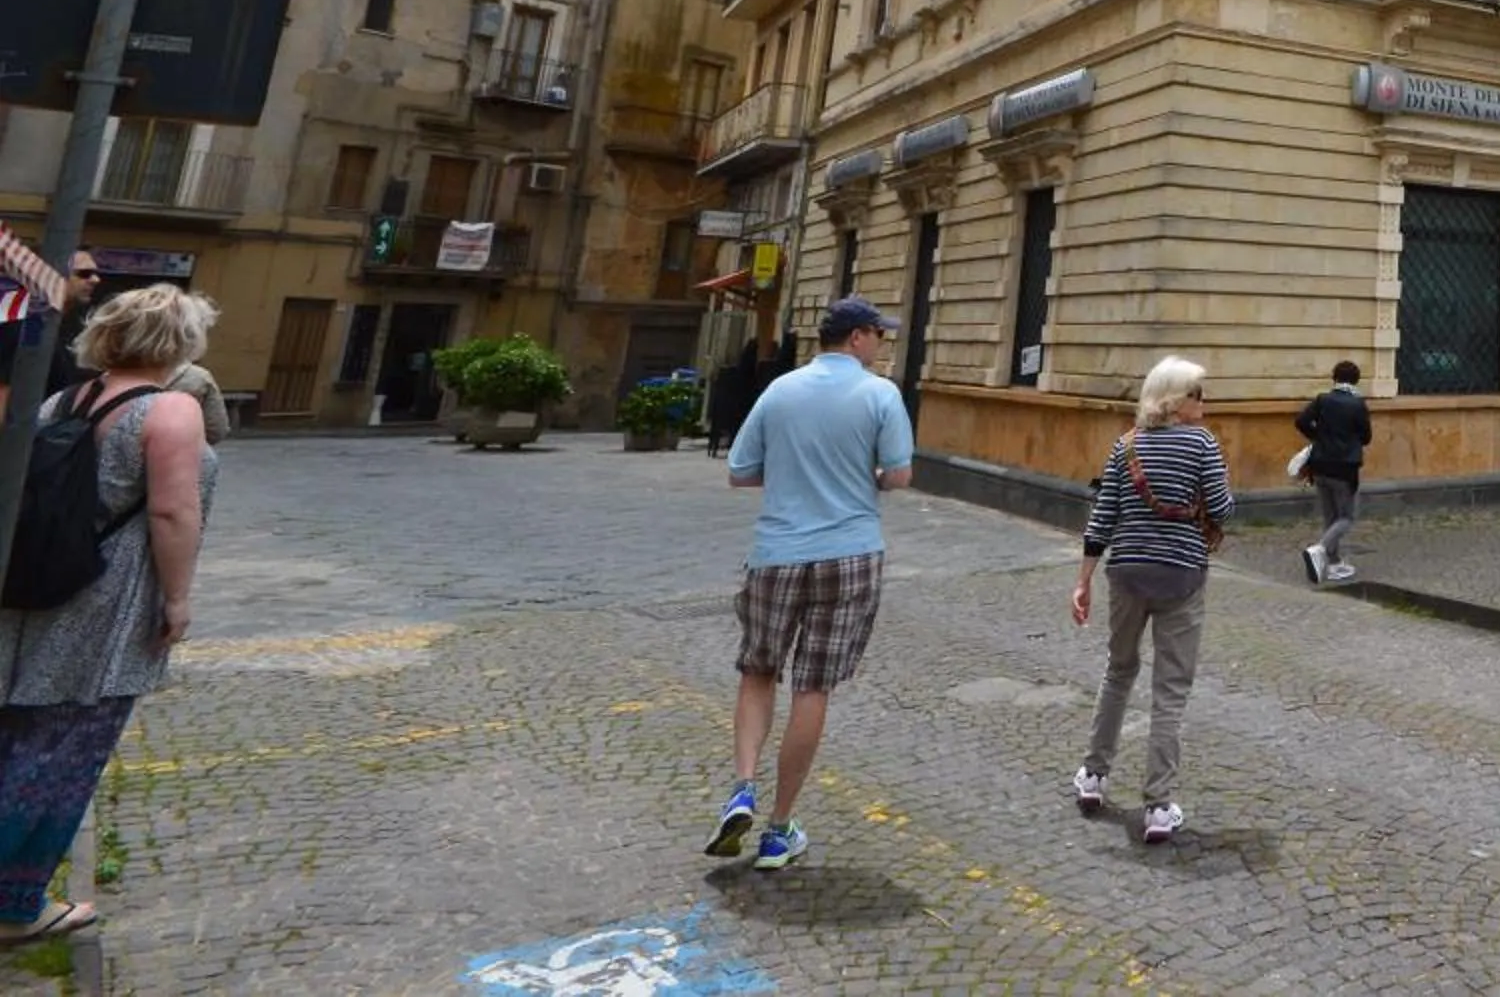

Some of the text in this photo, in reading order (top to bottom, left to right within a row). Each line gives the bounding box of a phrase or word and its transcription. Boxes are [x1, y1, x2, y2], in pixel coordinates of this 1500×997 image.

[1407, 76, 1468, 100] MONTE
[1405, 93, 1427, 110] DI
[1428, 97, 1480, 119] SIENA
